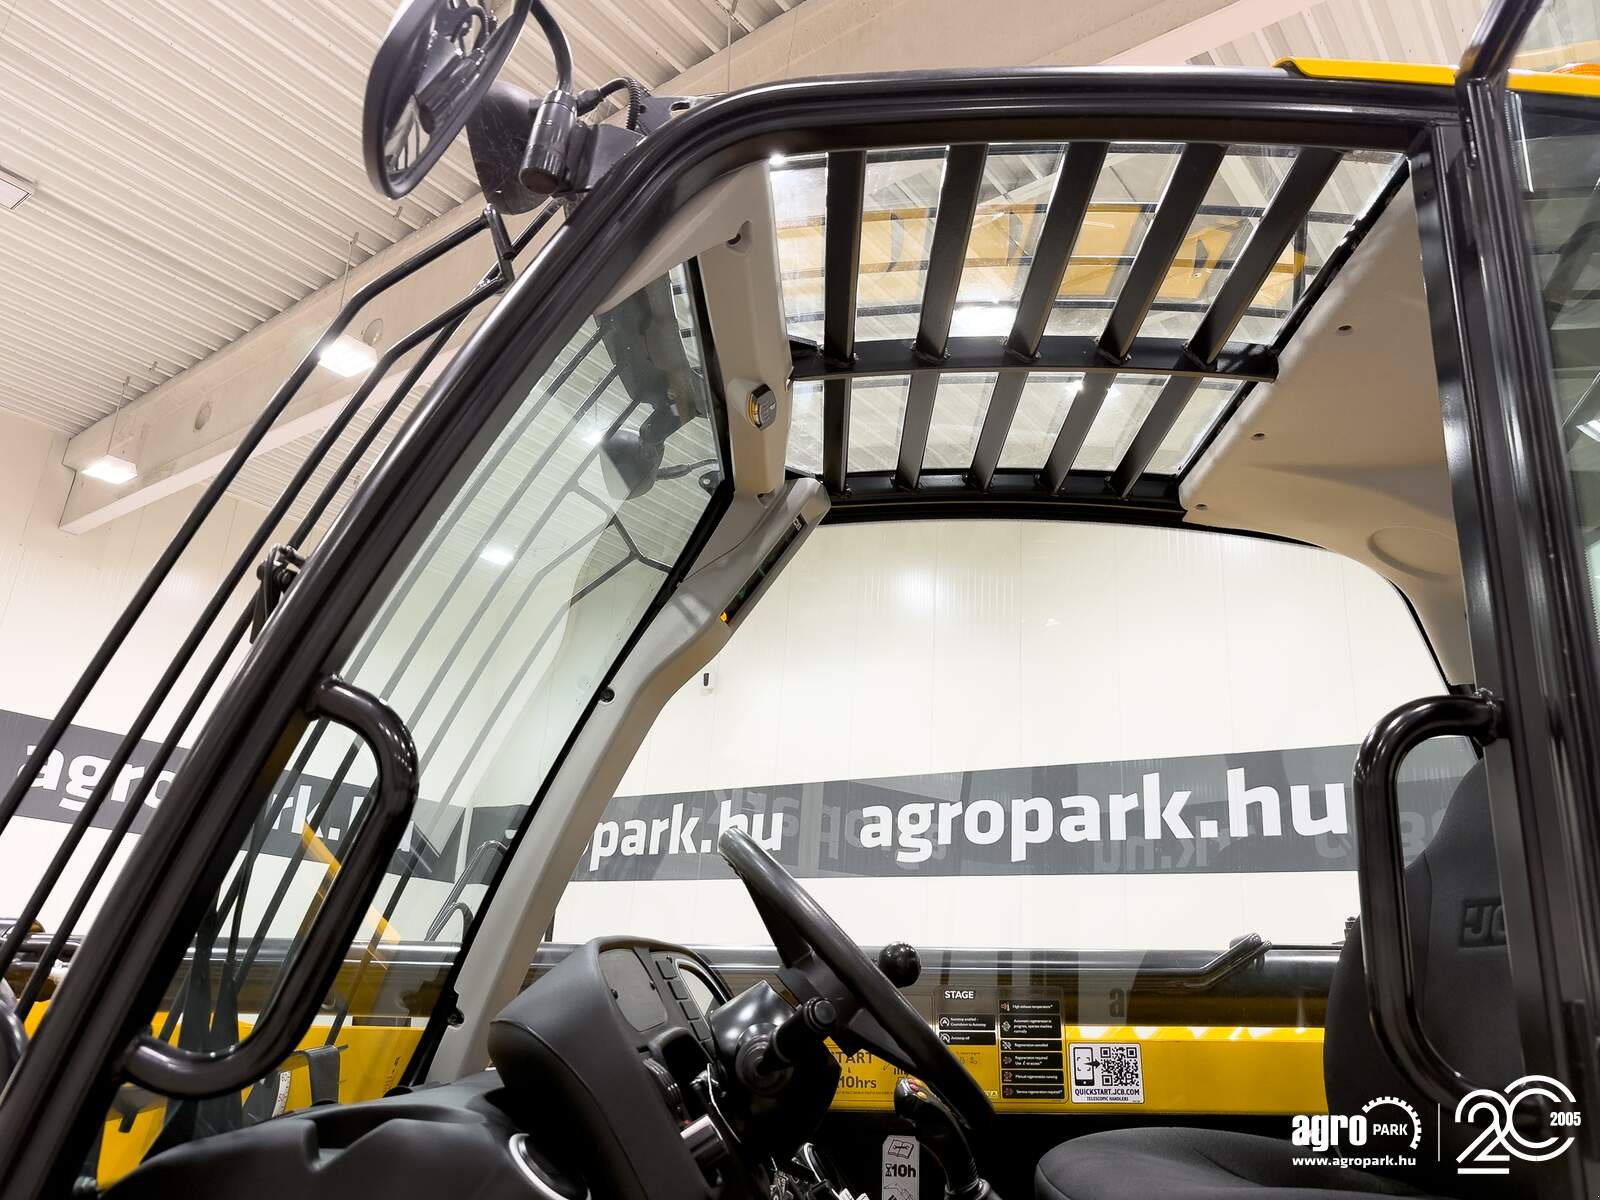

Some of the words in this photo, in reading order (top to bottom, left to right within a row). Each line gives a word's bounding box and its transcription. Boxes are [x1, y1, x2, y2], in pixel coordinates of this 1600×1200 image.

[860, 768, 1348, 863] agropark.hu
[944, 990, 974, 999] STAGE
[832, 1052, 873, 1064] TART
[1075, 1088, 1140, 1097] QUICKSTART.JCB.COM
[892, 1164, 917, 1178] 10h
